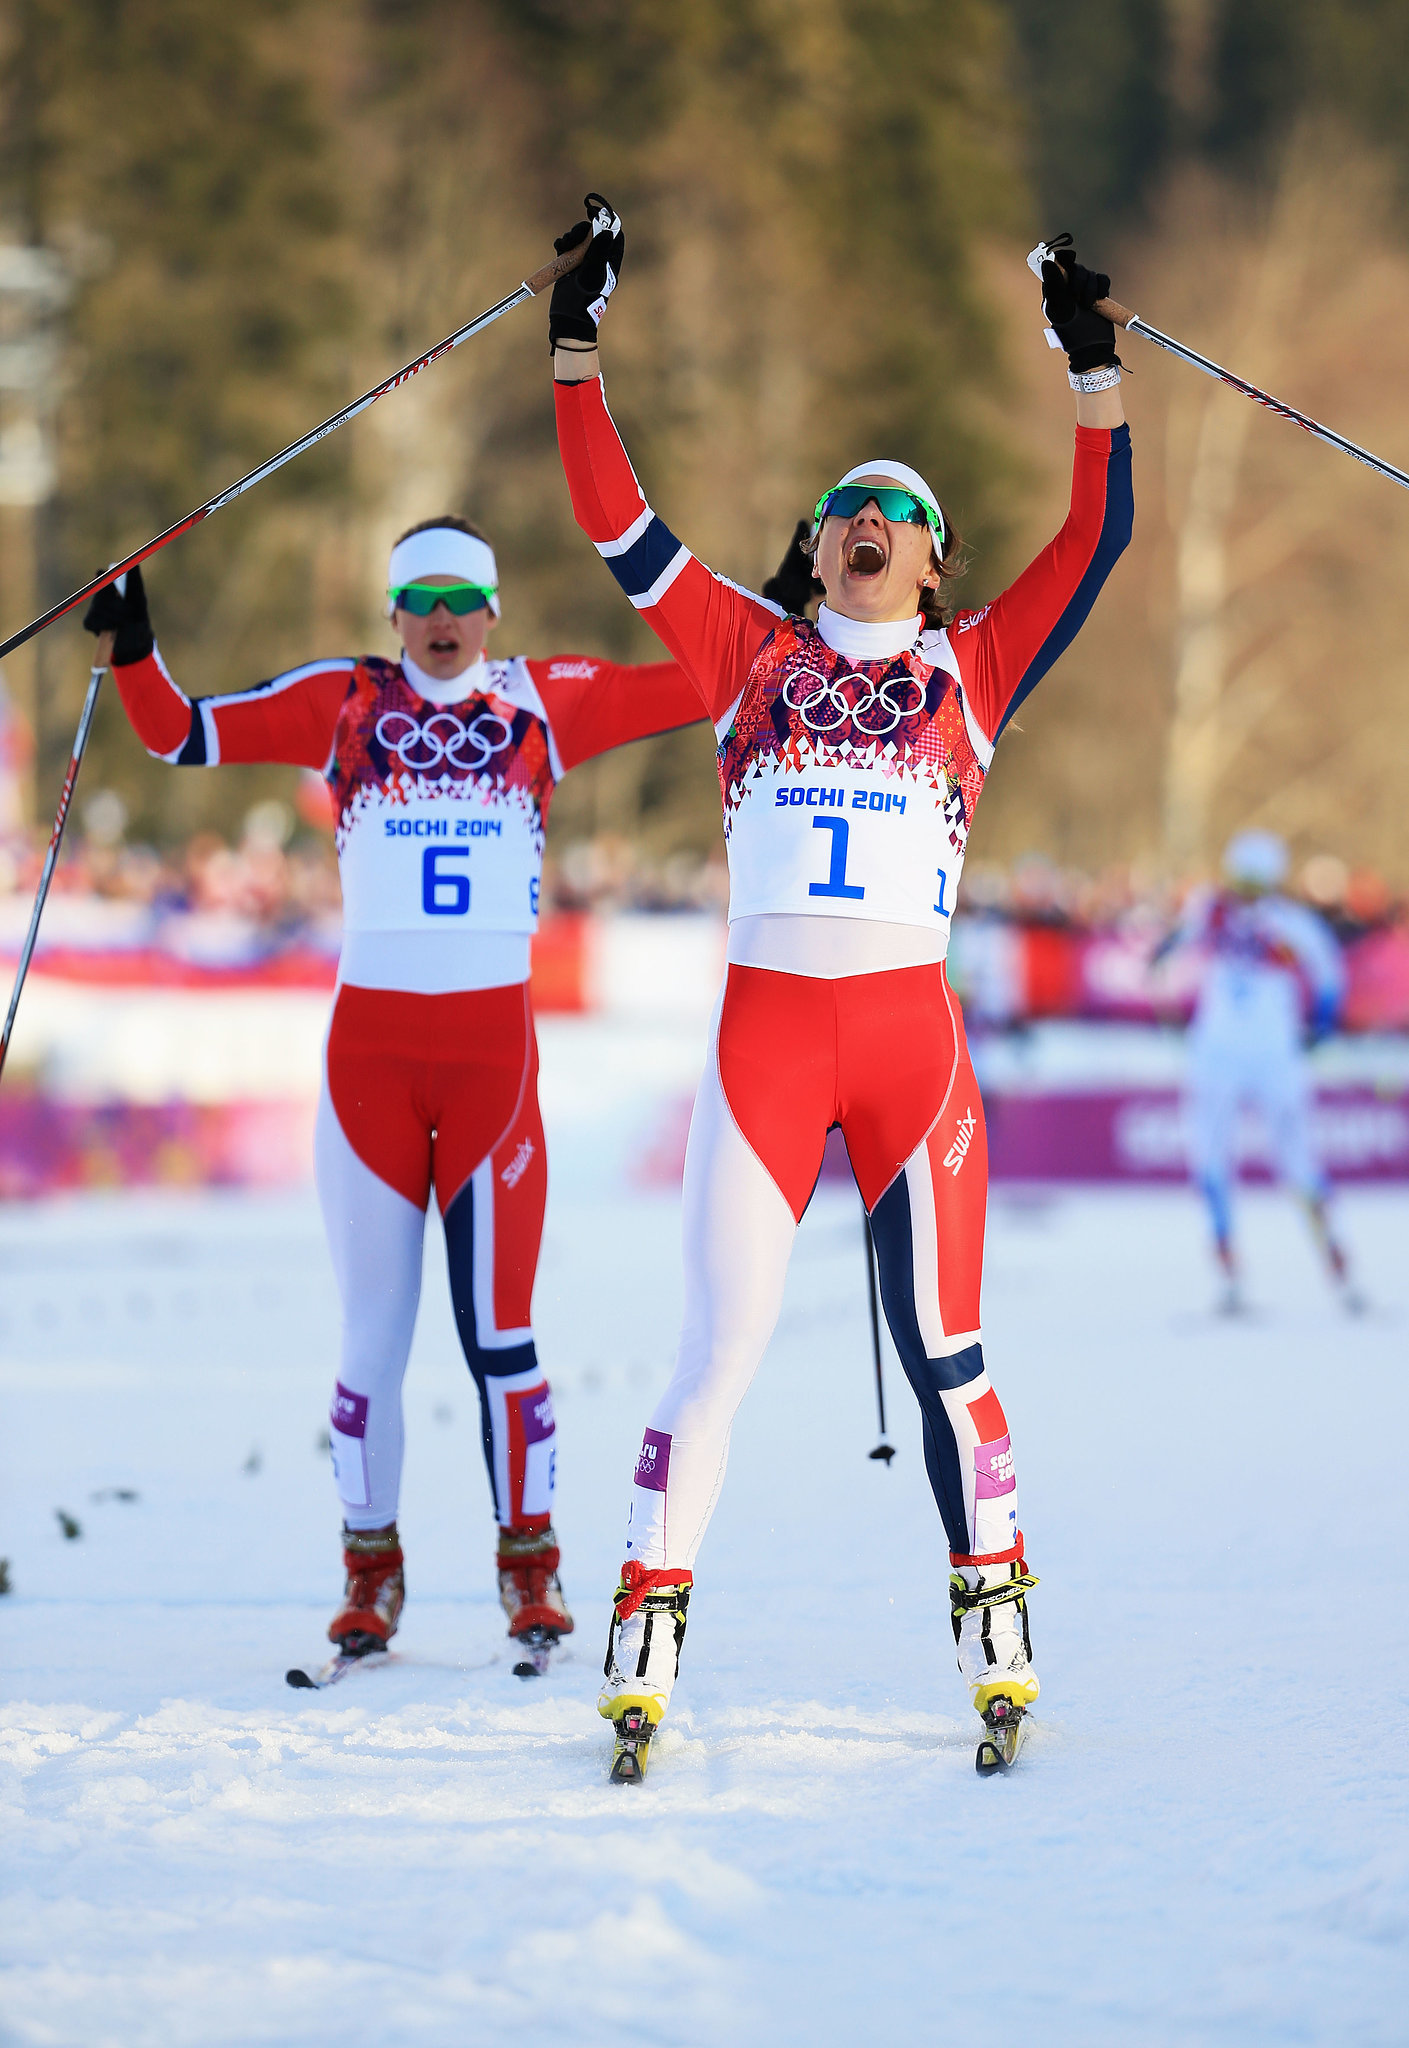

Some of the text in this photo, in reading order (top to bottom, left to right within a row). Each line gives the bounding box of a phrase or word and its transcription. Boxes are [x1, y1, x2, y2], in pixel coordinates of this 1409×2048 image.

[774, 787, 907, 815] SOCHI 2014
[384, 819, 502, 837] SOCHI 2014
[808, 815, 865, 900] 1
[422, 846, 471, 915] 6
[933, 868, 950, 918] 1
[639, 1602, 671, 1610] CHER
[976, 1586, 1022, 1606] FISCHER
